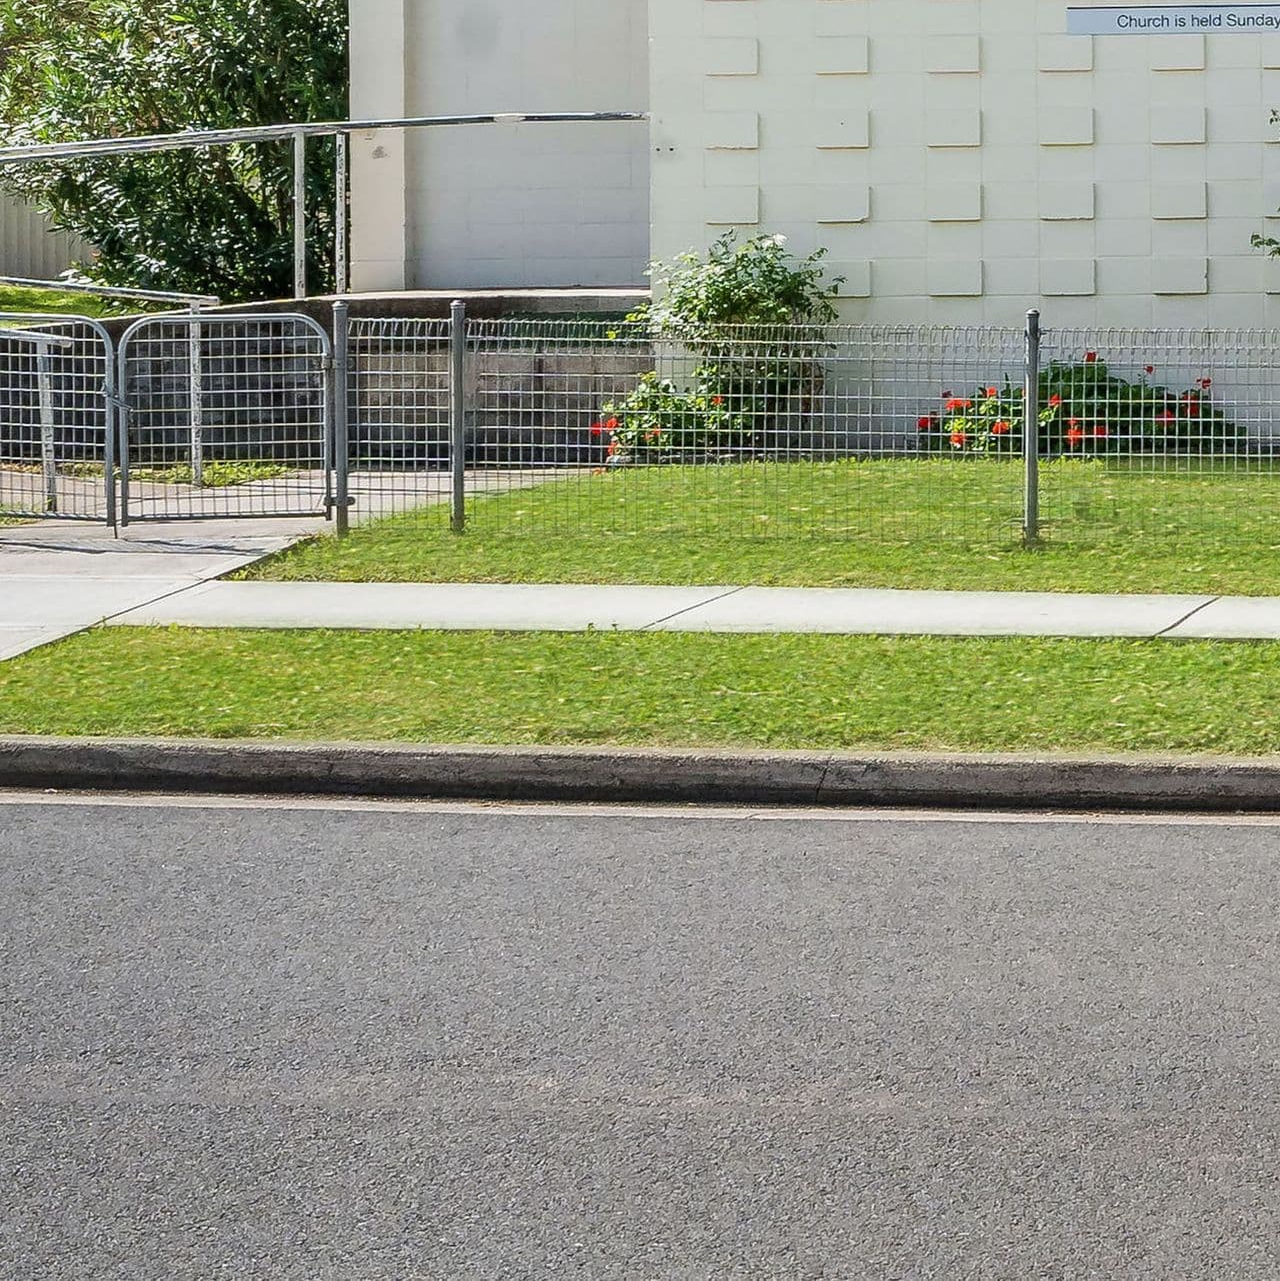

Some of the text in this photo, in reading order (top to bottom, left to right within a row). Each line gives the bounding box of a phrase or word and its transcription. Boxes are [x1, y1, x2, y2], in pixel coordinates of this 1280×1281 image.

[1116, 14, 1170, 28] Church
[1174, 14, 1186, 28] is
[1191, 14, 1222, 27] held
